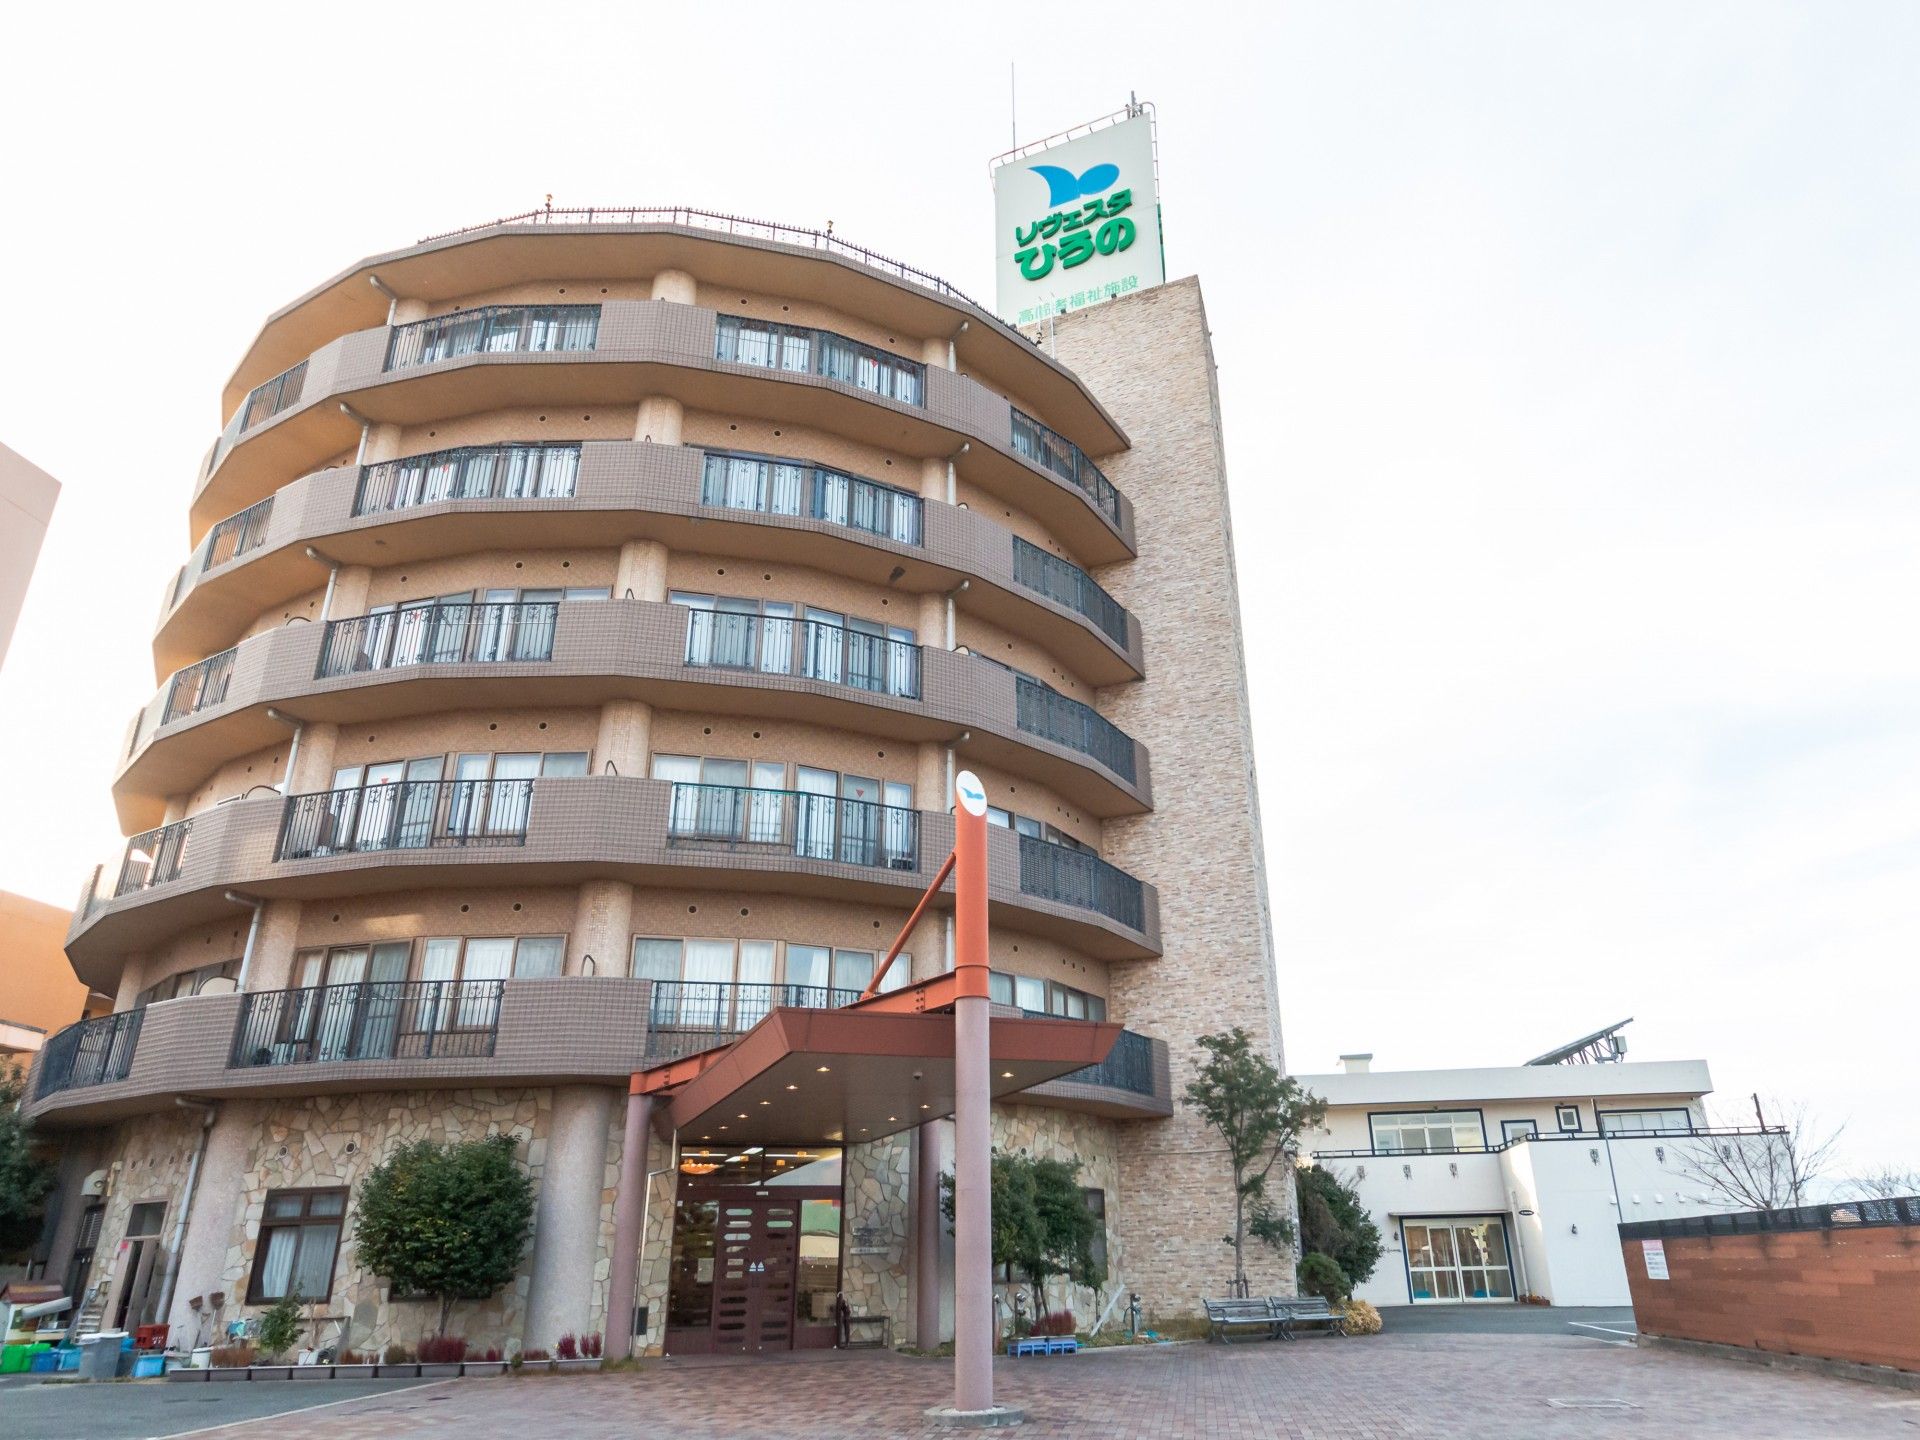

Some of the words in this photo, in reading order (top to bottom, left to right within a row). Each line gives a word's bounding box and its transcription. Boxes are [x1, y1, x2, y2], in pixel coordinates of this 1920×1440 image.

[1014, 216, 1136, 281] ひろの
[1018, 275, 1138, 324] 高齢者福祉施設
